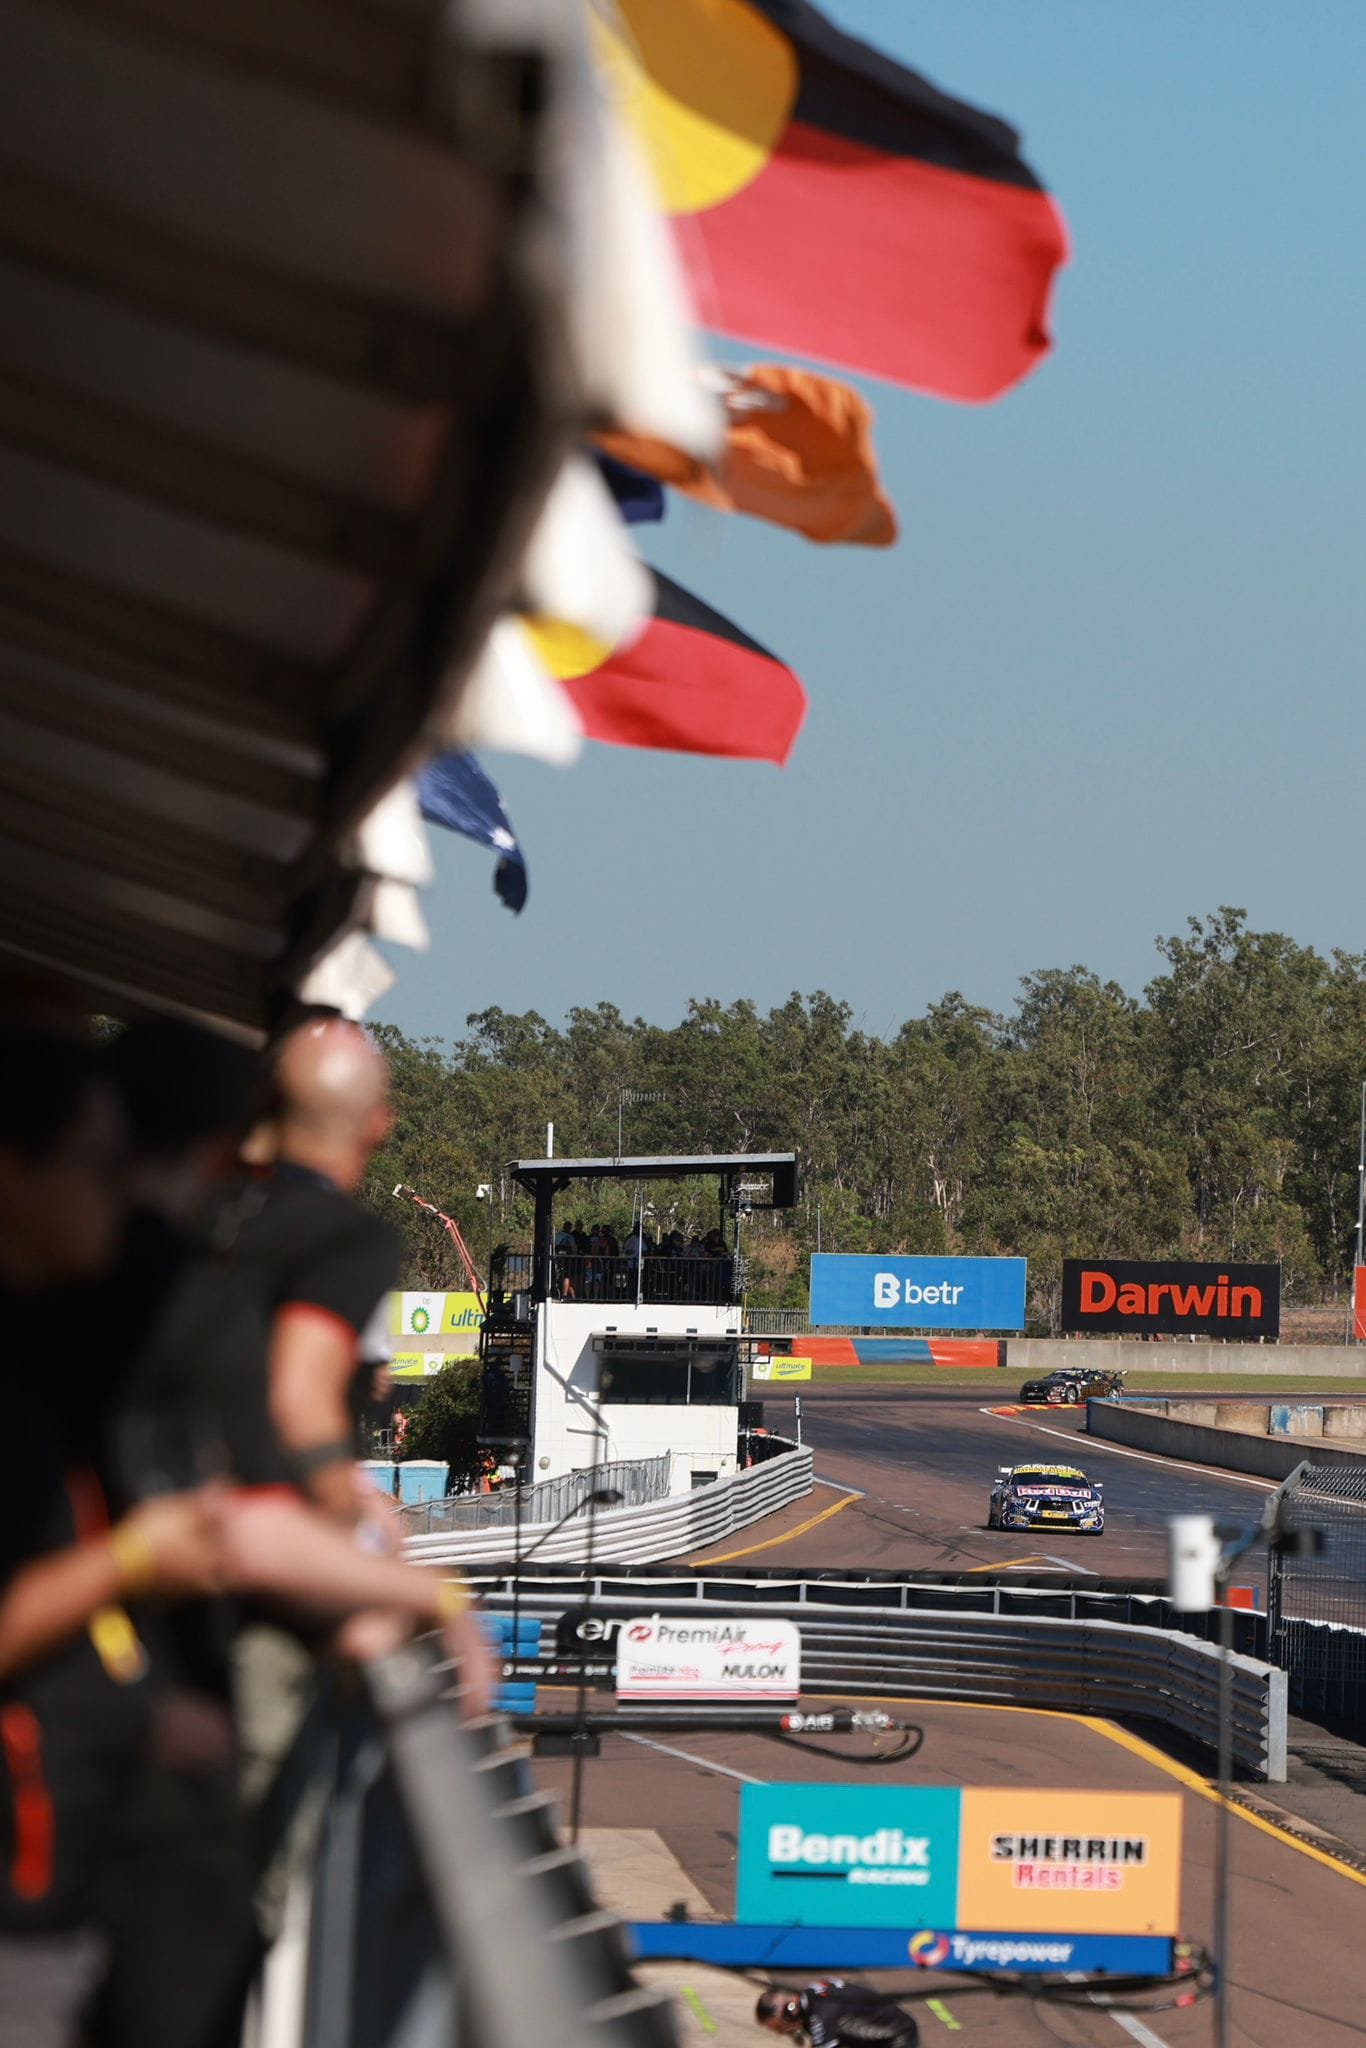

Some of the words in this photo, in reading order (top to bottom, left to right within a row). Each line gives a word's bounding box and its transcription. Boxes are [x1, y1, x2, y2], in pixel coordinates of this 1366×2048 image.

[905, 1278, 964, 1304] betr
[1079, 1271, 1263, 1318] Darwin
[656, 1624, 747, 1643] PremiAir
[721, 1664, 787, 1679] NULON
[768, 1824, 930, 1866] Bendix
[994, 1835, 1145, 1862] SHERRIN
[1017, 1863, 1121, 1889] Rentals
[952, 1935, 1074, 1966] Tyrepower
